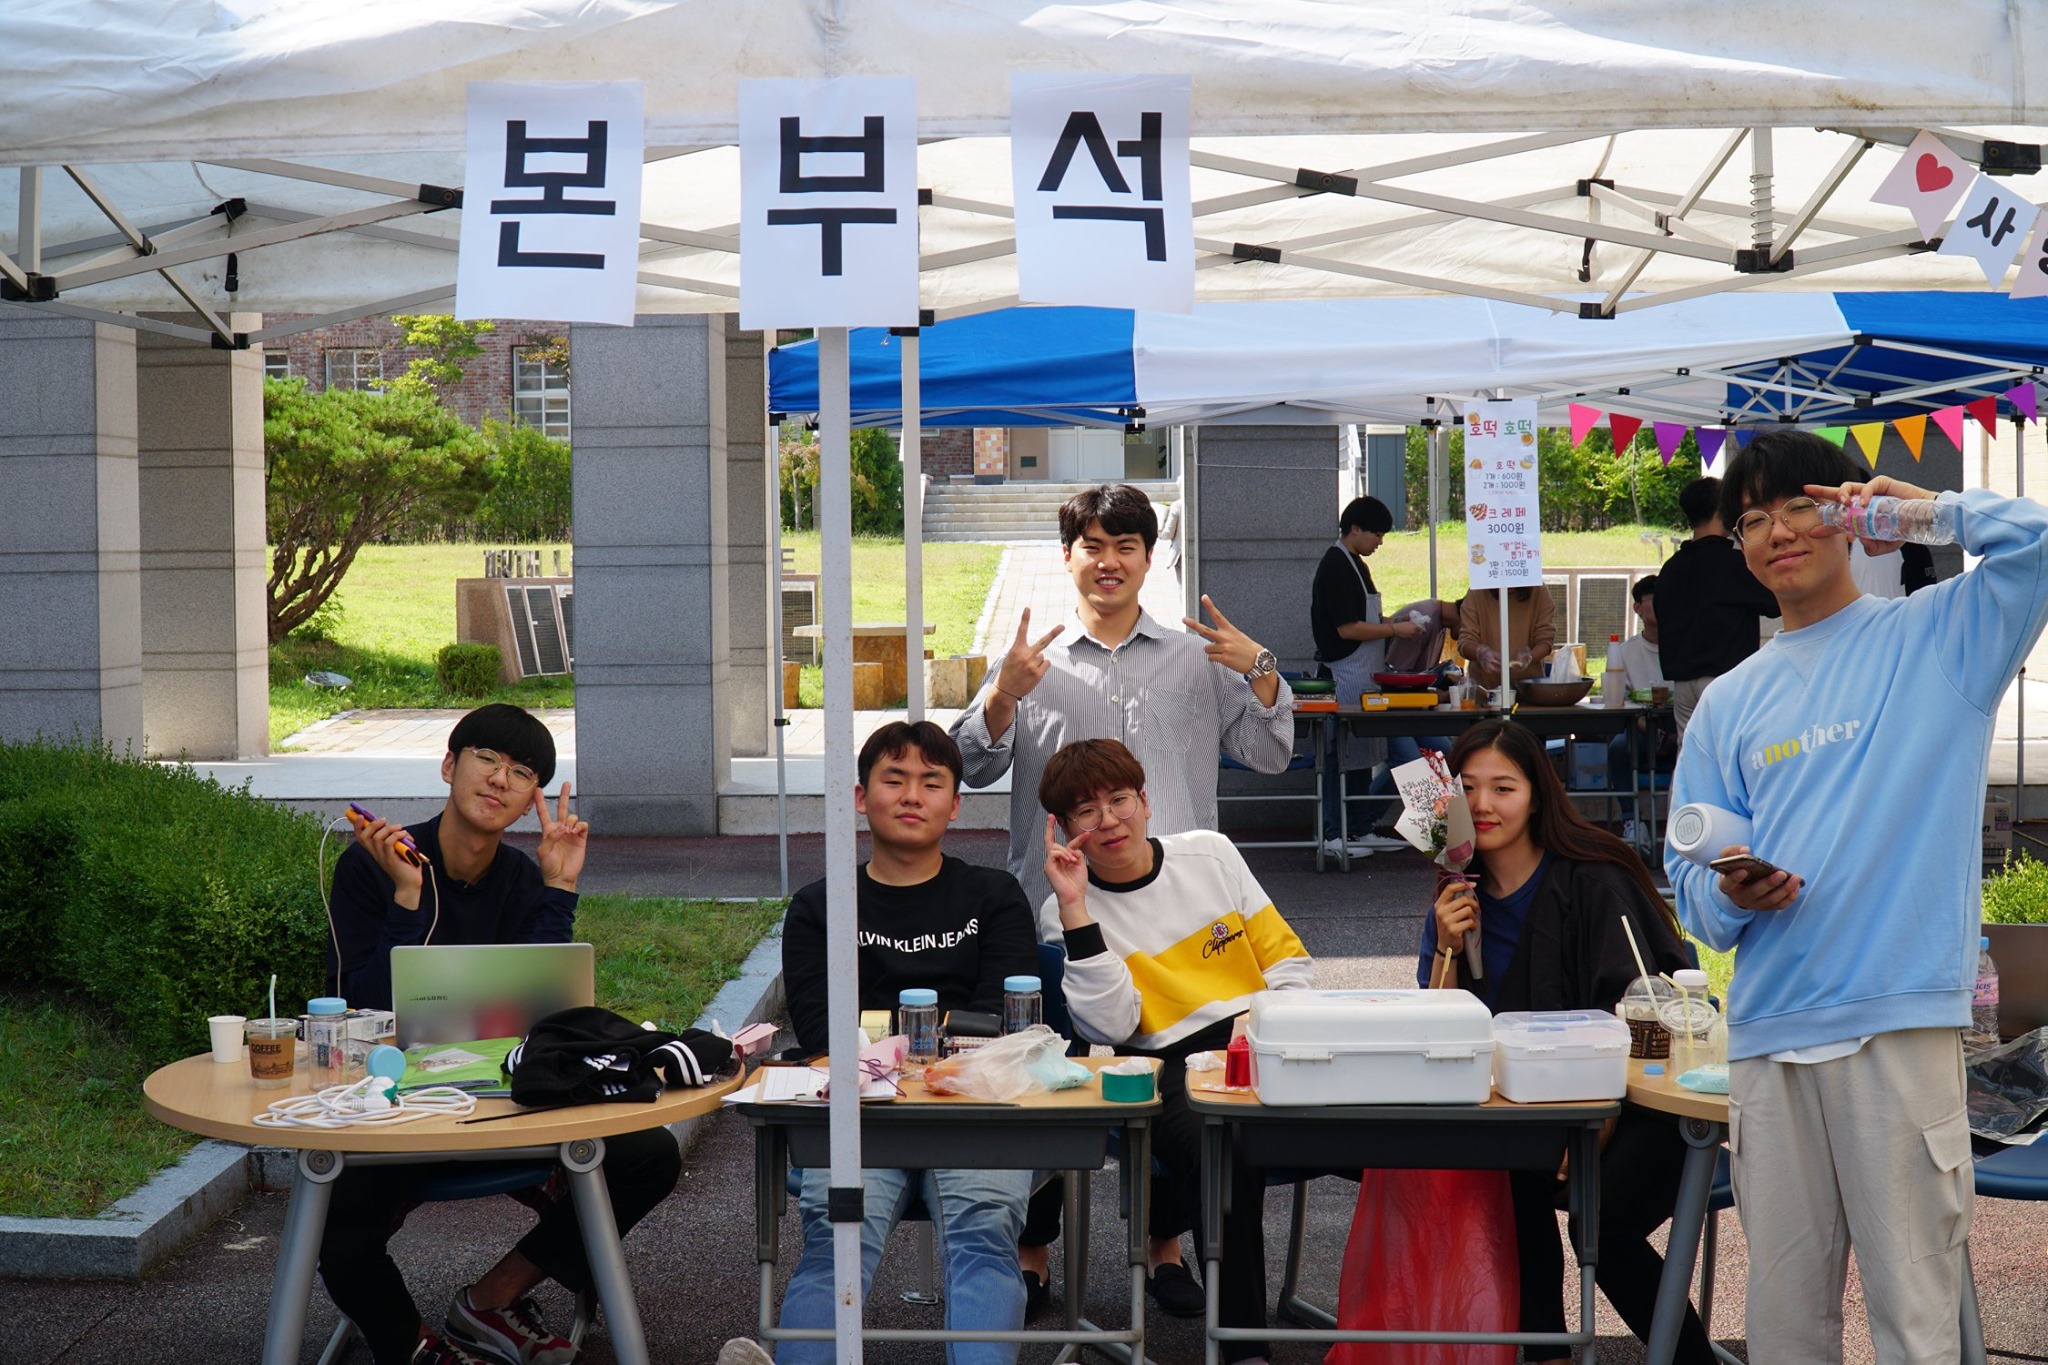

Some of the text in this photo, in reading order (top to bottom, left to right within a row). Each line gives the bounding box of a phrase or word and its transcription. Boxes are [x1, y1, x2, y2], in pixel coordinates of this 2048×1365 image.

[1966, 197, 2017, 247] 사
[1470, 420, 1532, 438] 호떡 호떡
[1502, 472, 1523, 481] 600원
[1501, 481, 1526, 489] 1000원
[1488, 522, 1524, 534] 3000원
[1506, 560, 1527, 568] 700원
[1505, 568, 1529, 577] 1500원
[1752, 719, 1861, 770] another
[857, 918, 979, 953] LVIN KLEIN JEANS
[251, 1044, 282, 1055] COFFEE
